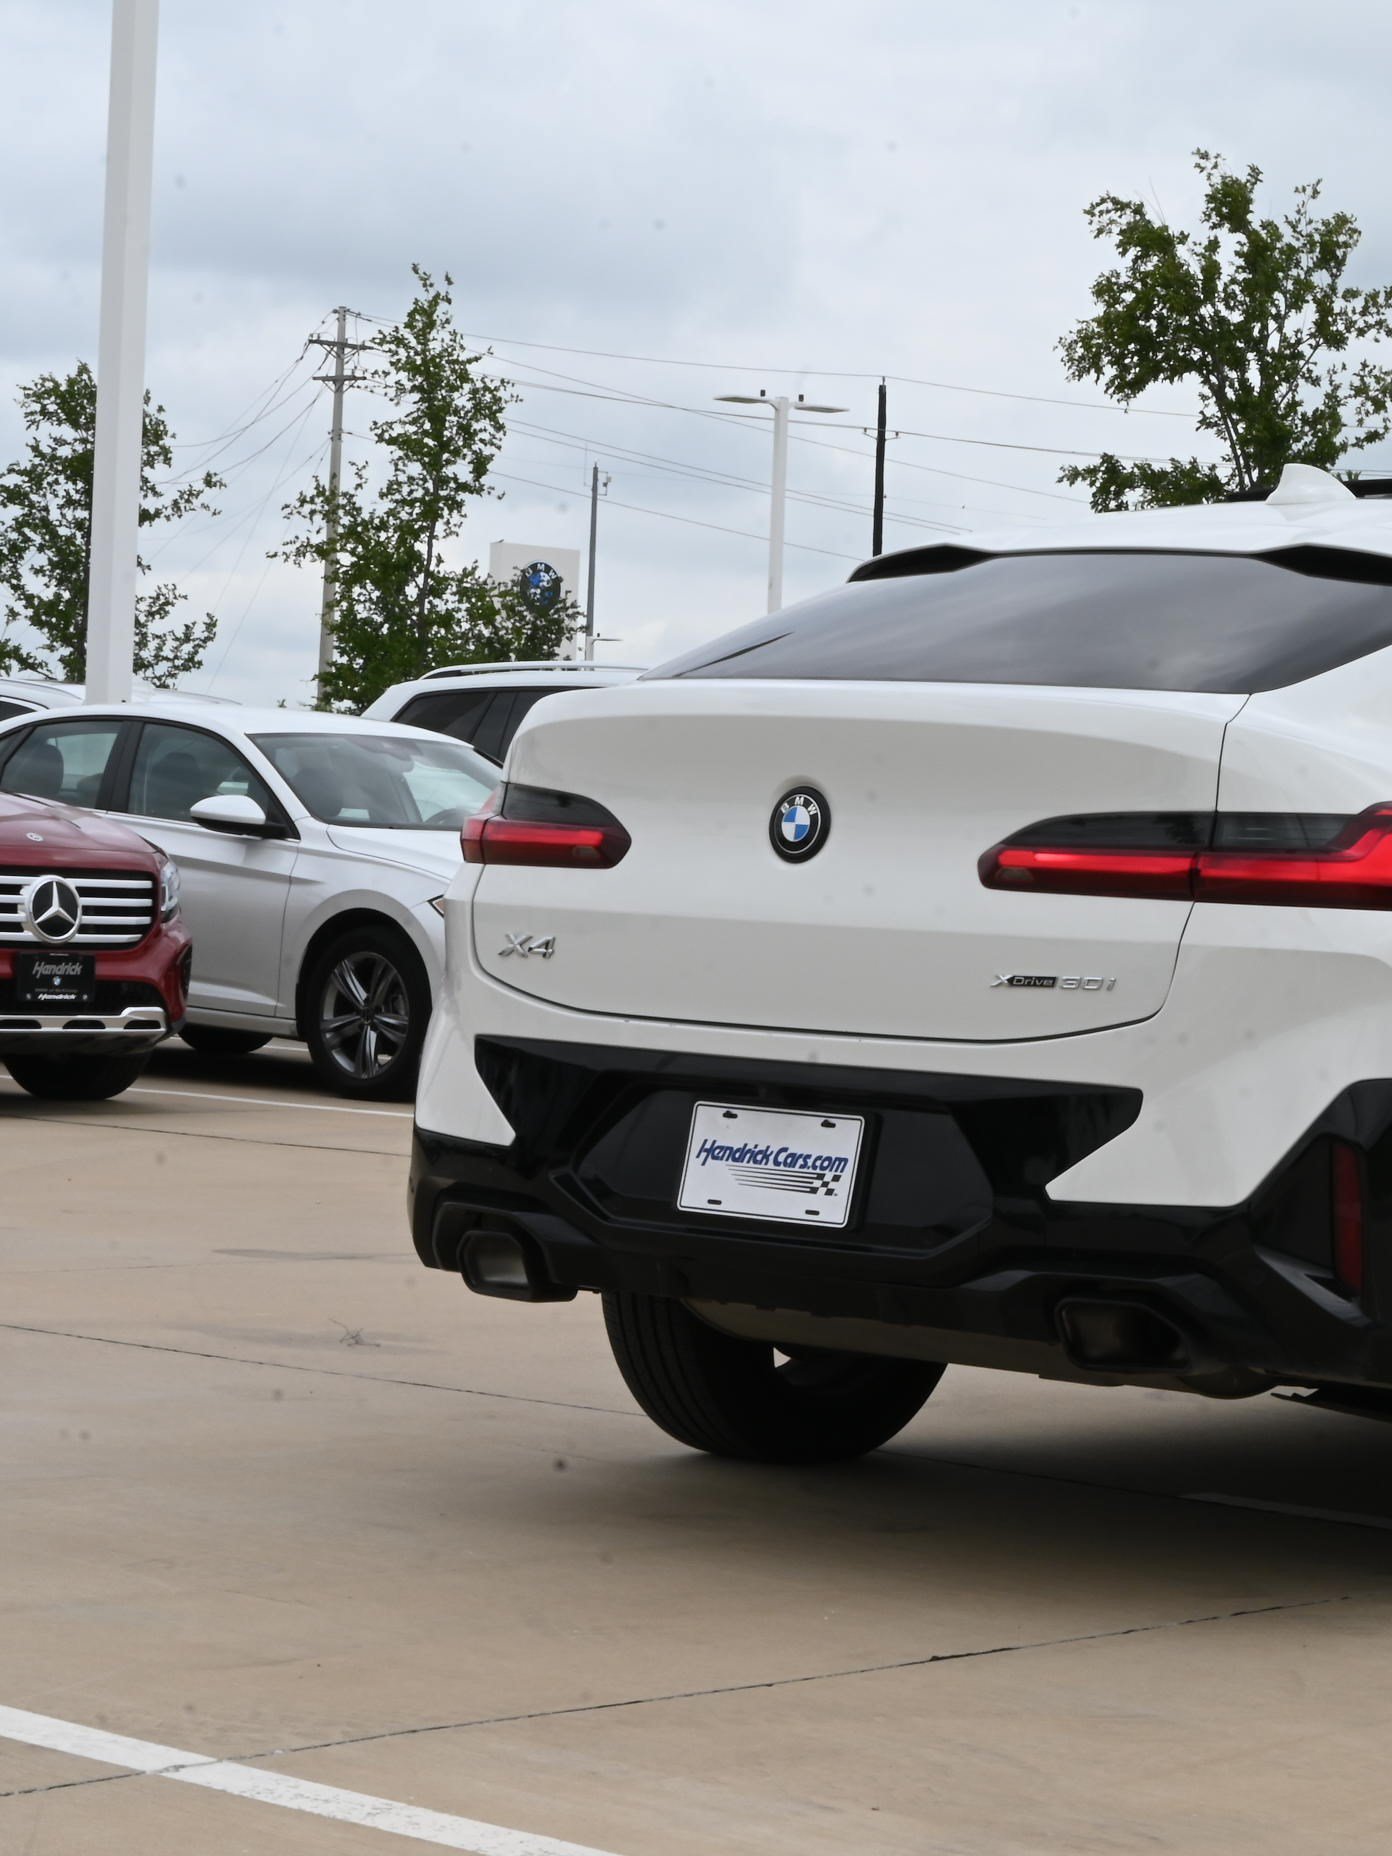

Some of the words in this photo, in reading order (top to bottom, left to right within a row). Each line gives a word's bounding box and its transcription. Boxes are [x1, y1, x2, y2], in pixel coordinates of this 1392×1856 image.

[780, 796, 818, 816] BMW
[498, 934, 556, 959] X4
[32, 961, 83, 979] Hendrick
[1061, 976, 1116, 991] 30i
